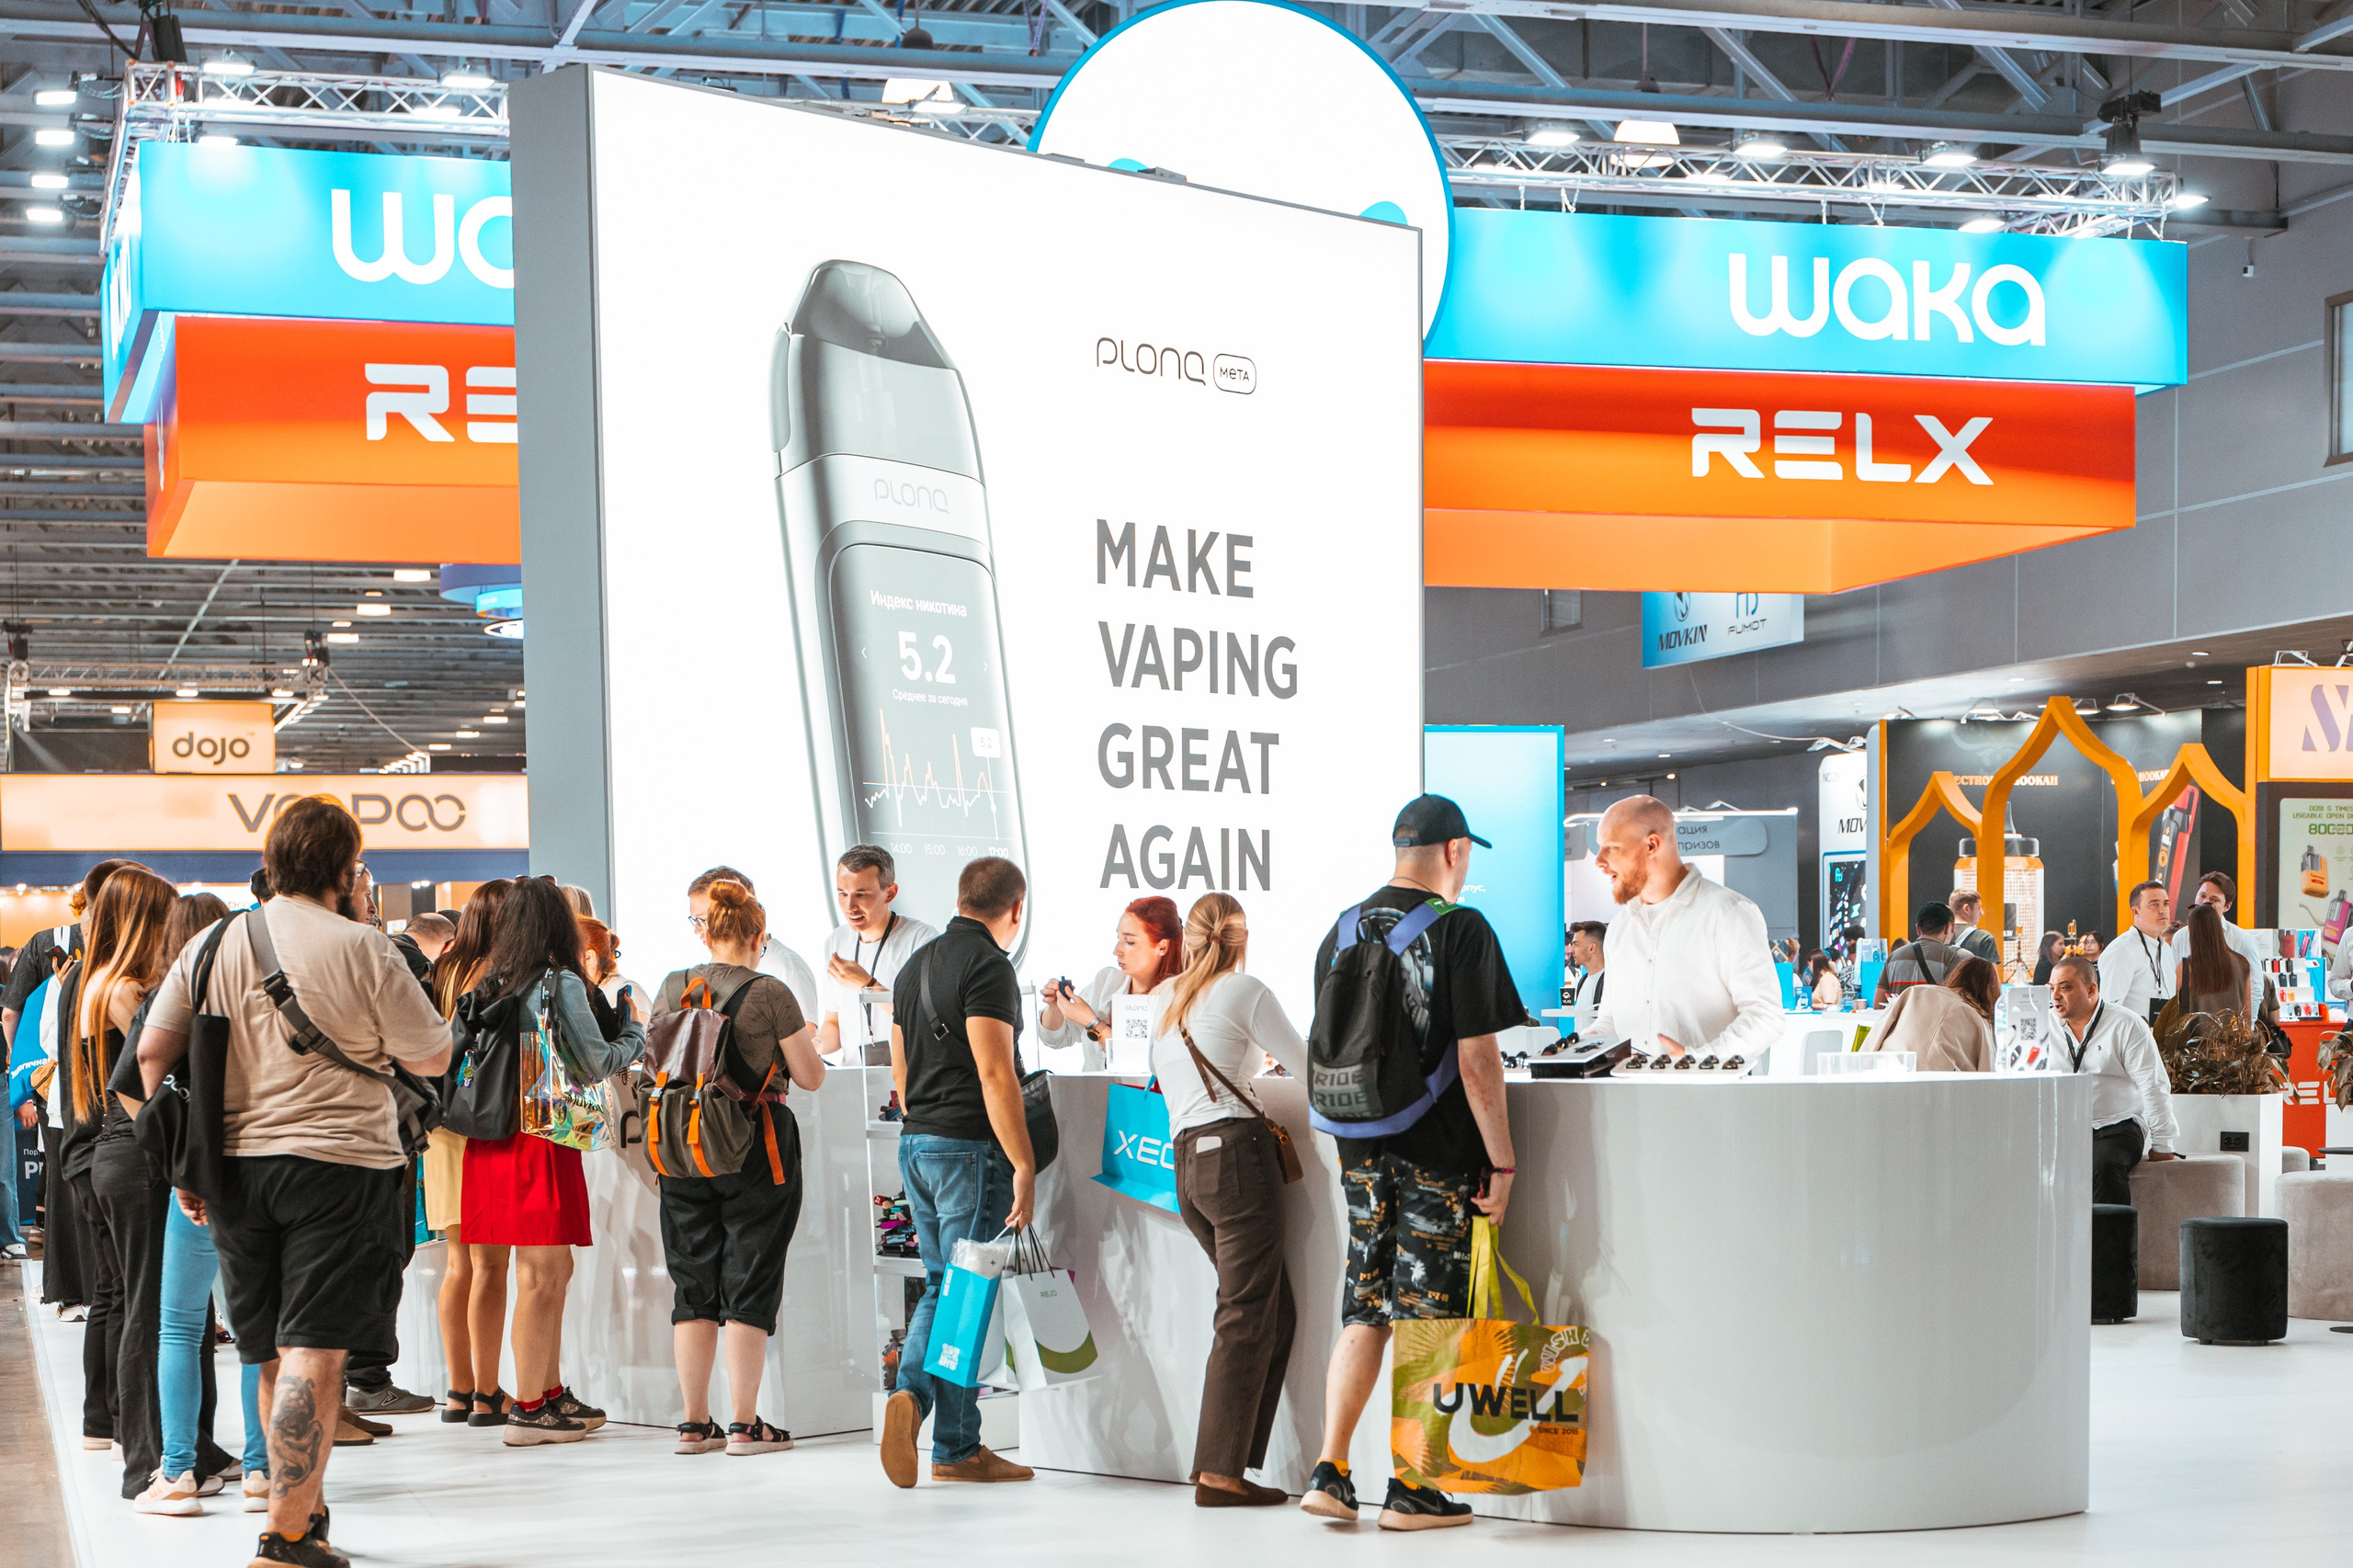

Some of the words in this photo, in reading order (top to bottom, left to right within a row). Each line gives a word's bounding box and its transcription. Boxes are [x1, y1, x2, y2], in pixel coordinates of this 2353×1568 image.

[1691, 407, 1994, 485] RELX
[1096, 518, 1254, 599] MAKE
[870, 589, 915, 611] Индекс
[915, 598, 968, 618] никотина
[1657, 624, 1708, 652] MOVKIN
[1728, 619, 1767, 636] FUMOT
[898, 631, 956, 684] 5.2
[1098, 621, 1298, 699] VAPING
[892, 688, 926, 702] Среднее
[927, 695, 937, 703] за
[938, 695, 968, 707] сегодня
[172, 732, 250, 766] dojo
[1097, 722, 1280, 794] GREAT
[227, 793, 466, 833] VPOO
[891, 843, 912, 854] 14:00
[924, 844, 946, 856] 15:00
[957, 845, 978, 857] 16:00
[1099, 824, 1271, 892] AGAIN
[1433, 1382, 1579, 1423] UWELL
